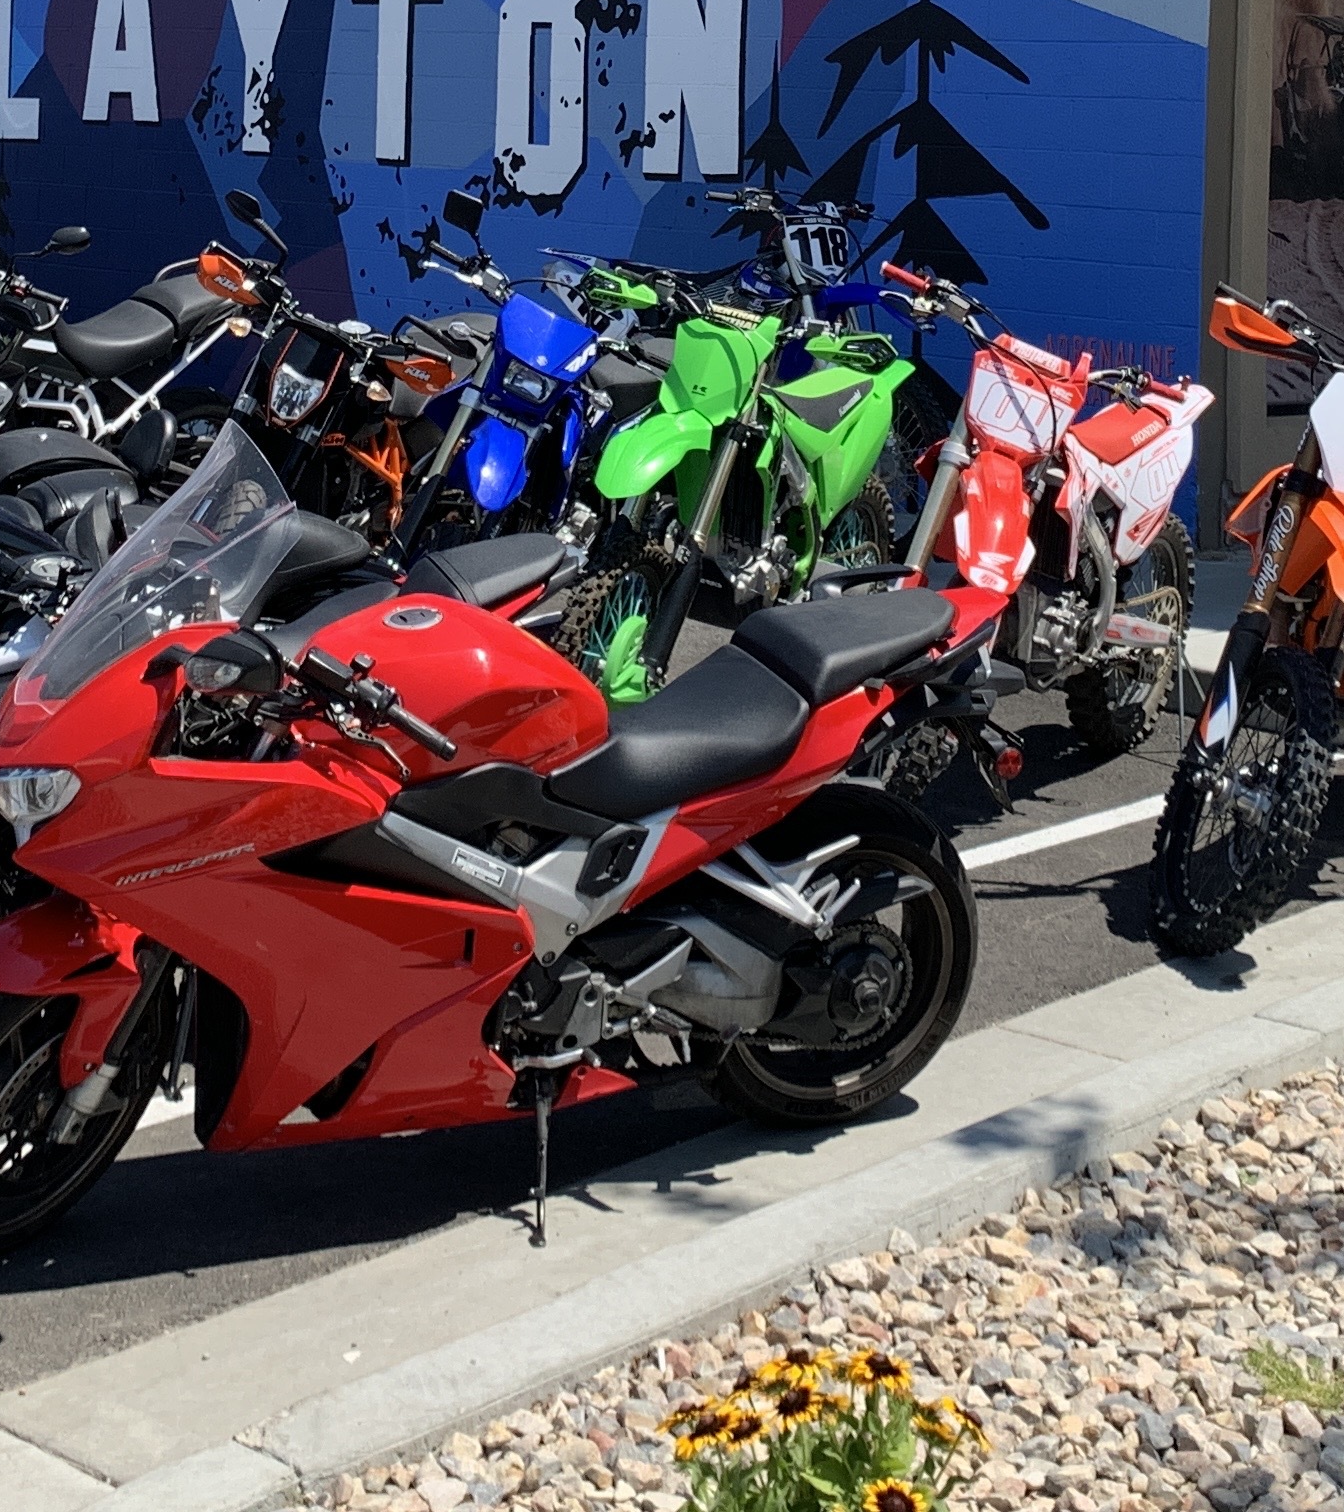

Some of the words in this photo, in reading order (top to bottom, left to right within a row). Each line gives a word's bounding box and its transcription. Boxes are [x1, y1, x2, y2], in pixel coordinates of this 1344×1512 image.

[790, 226, 849, 268] 118
[212, 274, 239, 293] KTM
[404, 366, 431, 382] KTM
[1046, 334, 1176, 378] ADRENALINE
[976, 381, 1065, 455] 04
[1130, 420, 1164, 448] HONDA
[1146, 450, 1184, 503] 04
[1268, 504, 1296, 552] Ride
[1253, 552, 1281, 602] Shop
[114, 841, 256, 888] INTERCEPTOR
